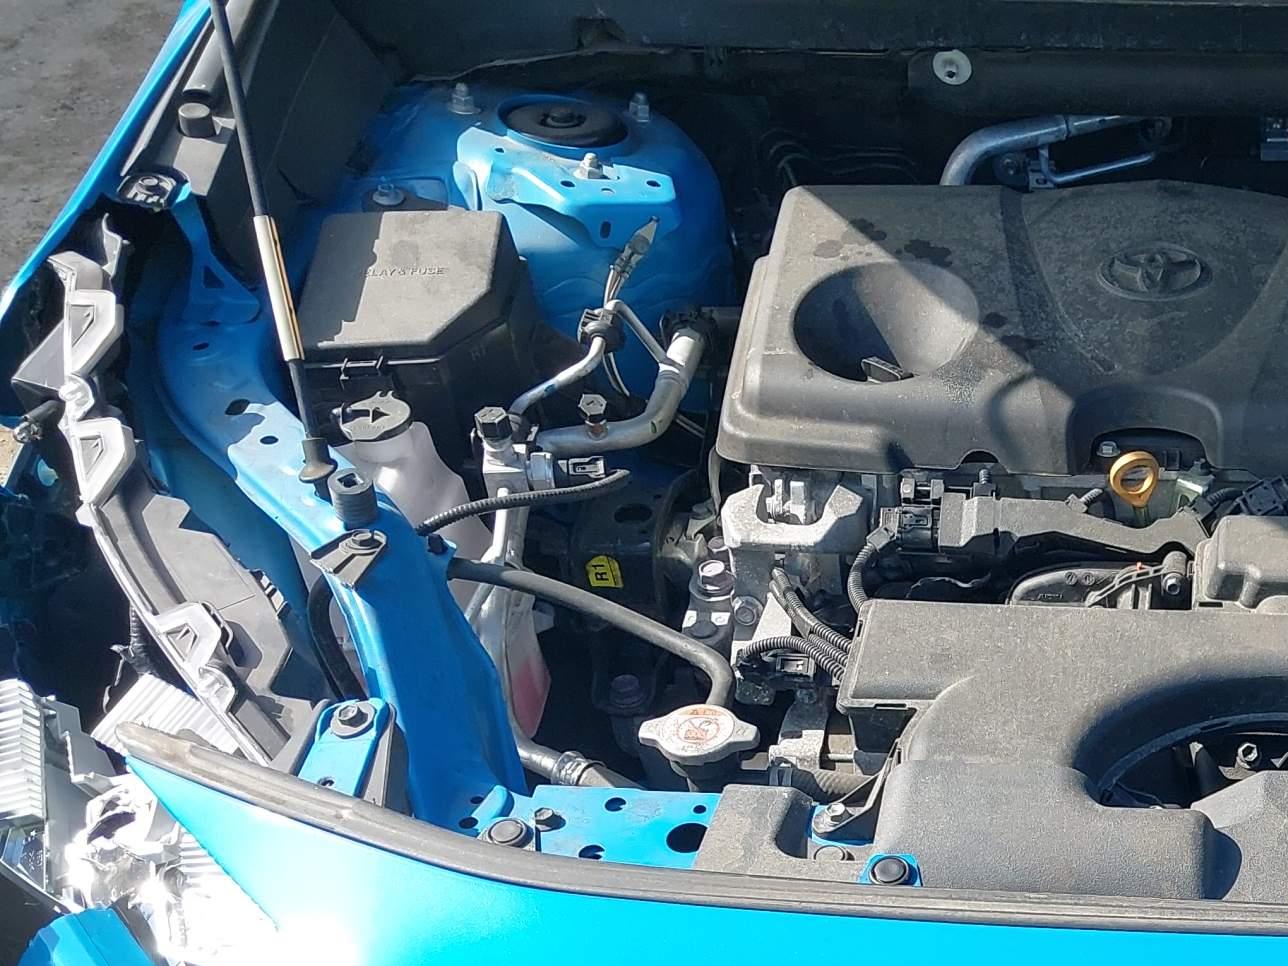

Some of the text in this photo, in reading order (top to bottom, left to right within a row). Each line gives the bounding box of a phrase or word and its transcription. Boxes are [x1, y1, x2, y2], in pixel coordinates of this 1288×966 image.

[358, 266, 396, 277] ELAY
[410, 266, 447, 276] FUSE
[591, 564, 609, 581] R1
